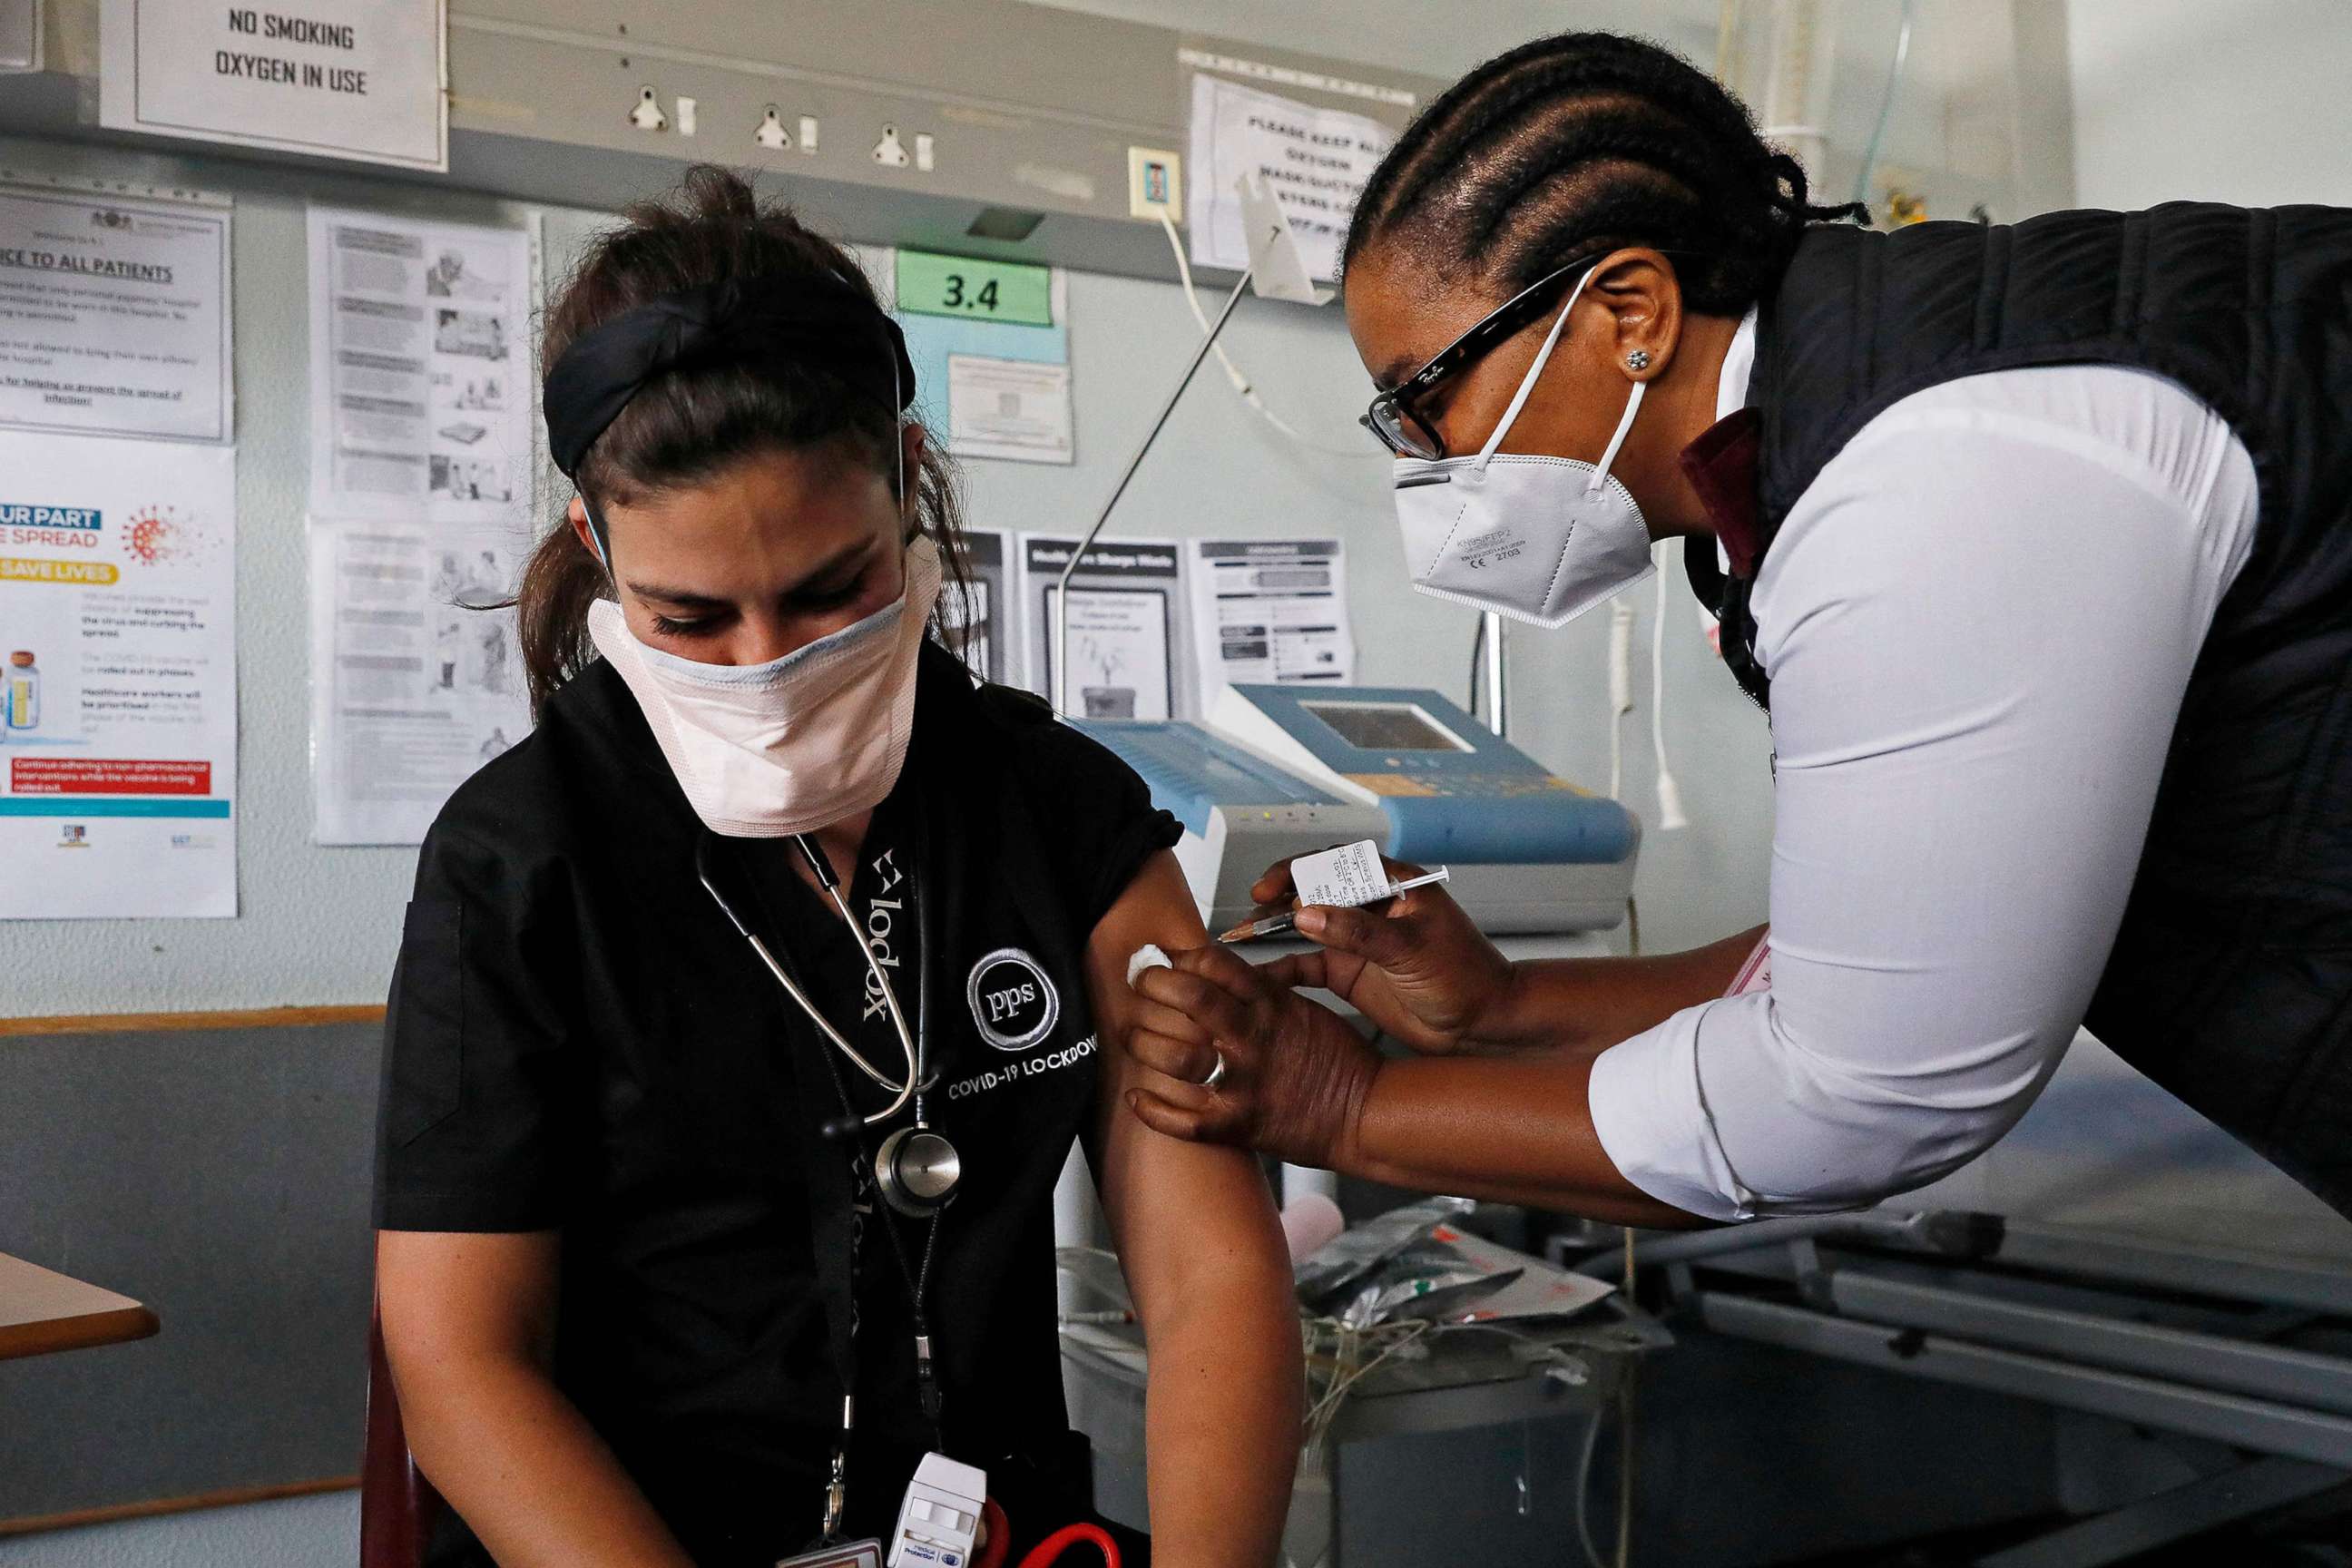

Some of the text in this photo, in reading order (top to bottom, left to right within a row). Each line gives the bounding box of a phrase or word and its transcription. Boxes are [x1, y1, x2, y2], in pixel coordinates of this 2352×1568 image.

[230, 9, 355, 50] NO SMOKING
[216, 50, 368, 95] OXYGEN IN USE
[31, 250, 54, 268] TO
[59, 254, 87, 271] ALL
[93, 257, 173, 282] PATIENTS
[944, 275, 999, 310] 3.4
[34, 507, 95, 528] PART
[13, 529, 98, 548] SPREAD
[1495, 548, 1521, 561] 2703
[2, 561, 112, 583] SAVE LIVES
[864, 898, 902, 1022] lodox
[985, 983, 1035, 1022] pps
[949, 1064, 1018, 1100] COVID-19
[905, 1547, 935, 1561] Protection
